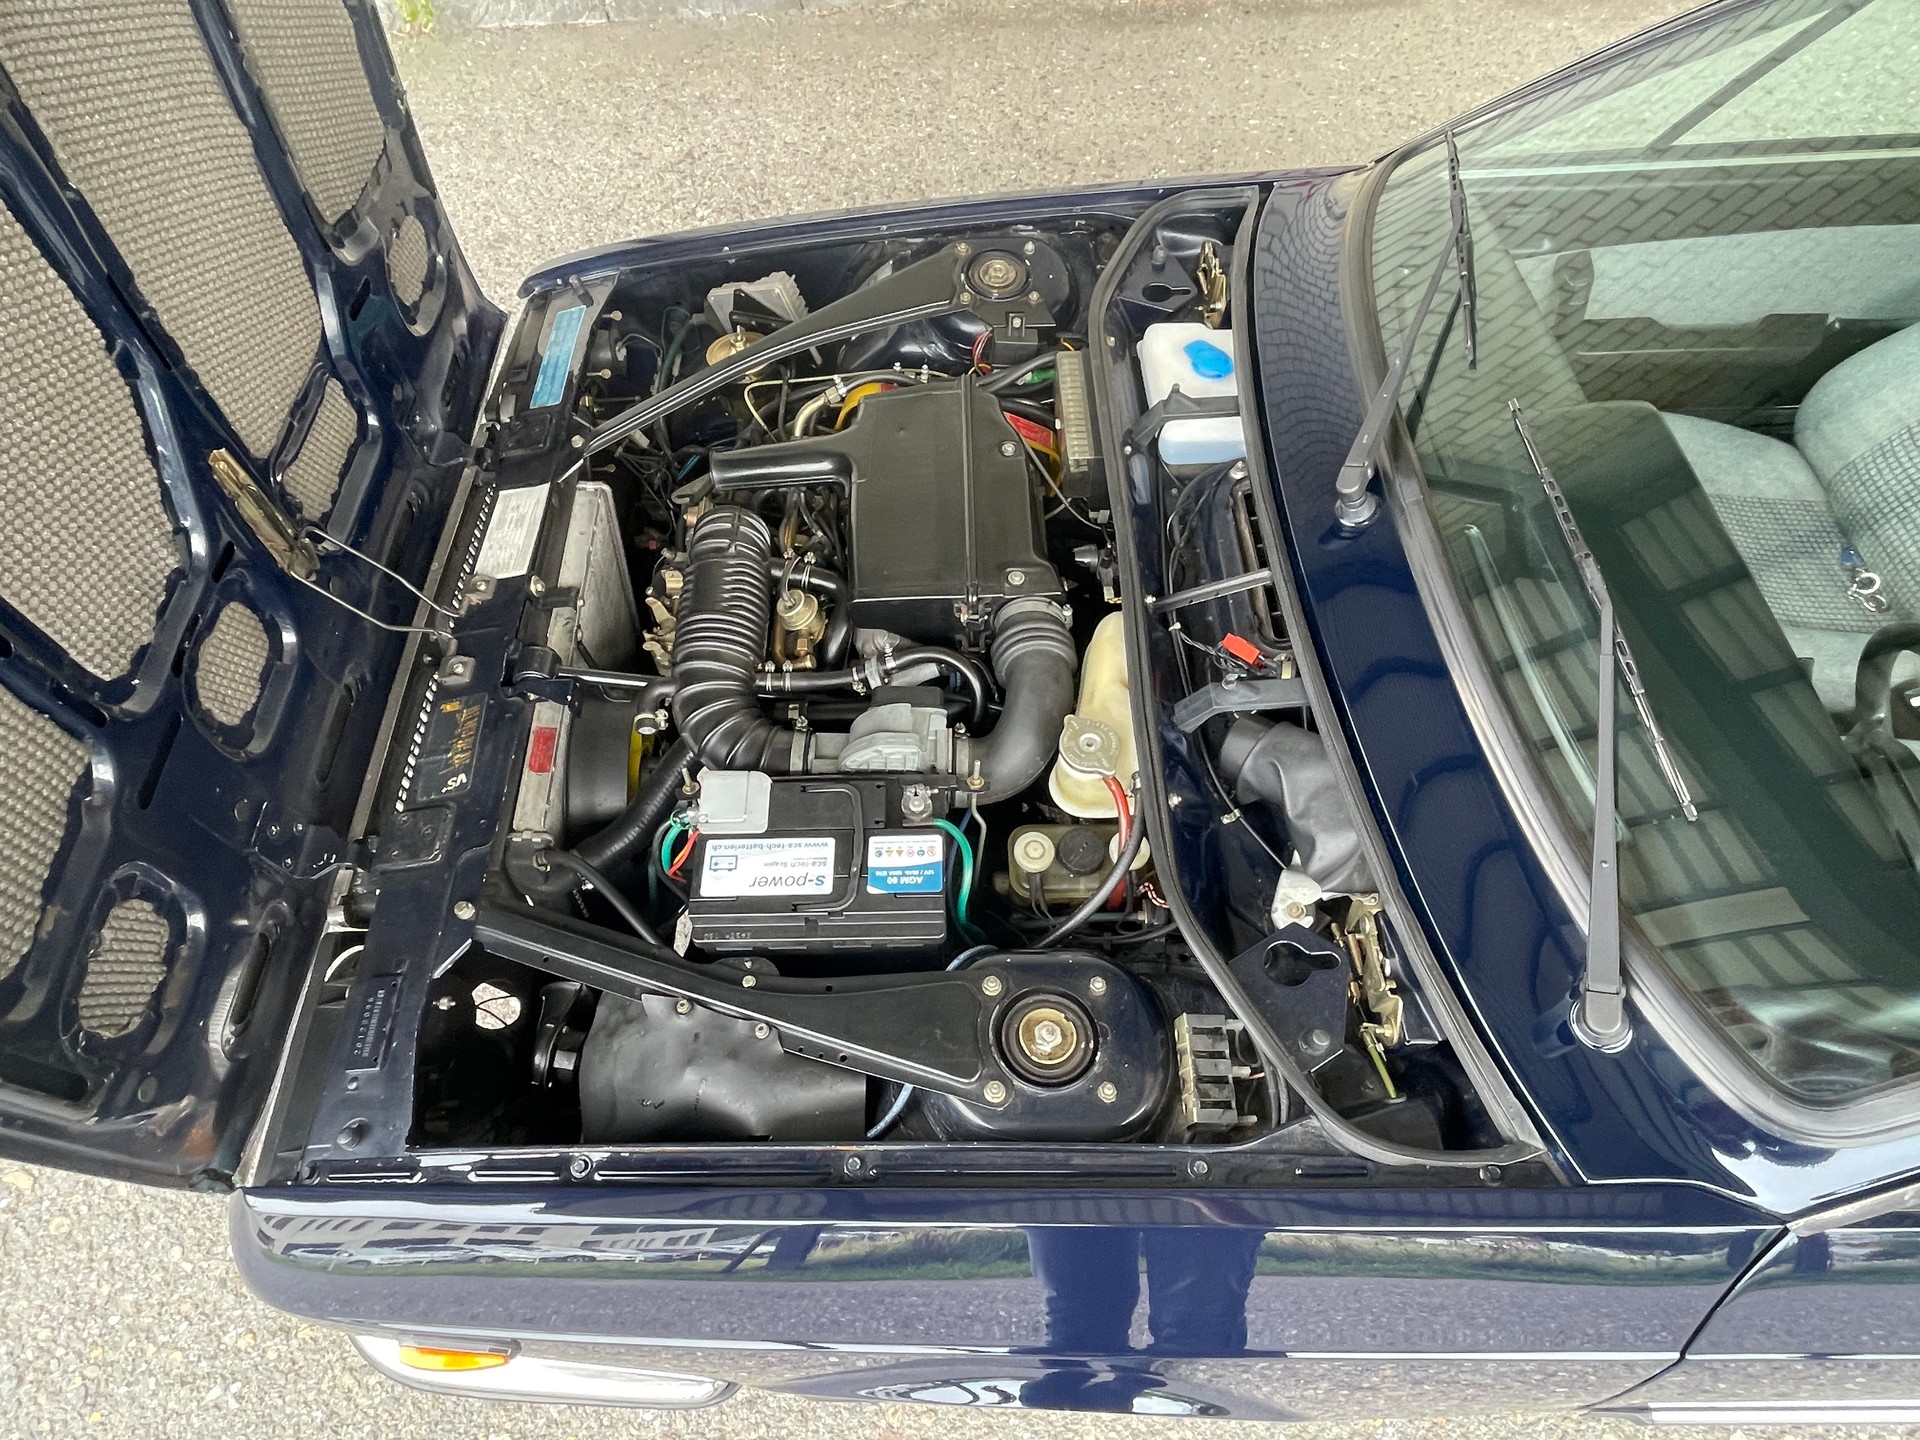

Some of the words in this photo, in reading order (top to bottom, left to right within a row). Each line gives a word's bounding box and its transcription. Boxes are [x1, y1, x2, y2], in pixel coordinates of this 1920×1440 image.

[749, 872, 827, 888] s-power
[886, 876, 899, 884] 60
[900, 876, 924, 884] AGM
